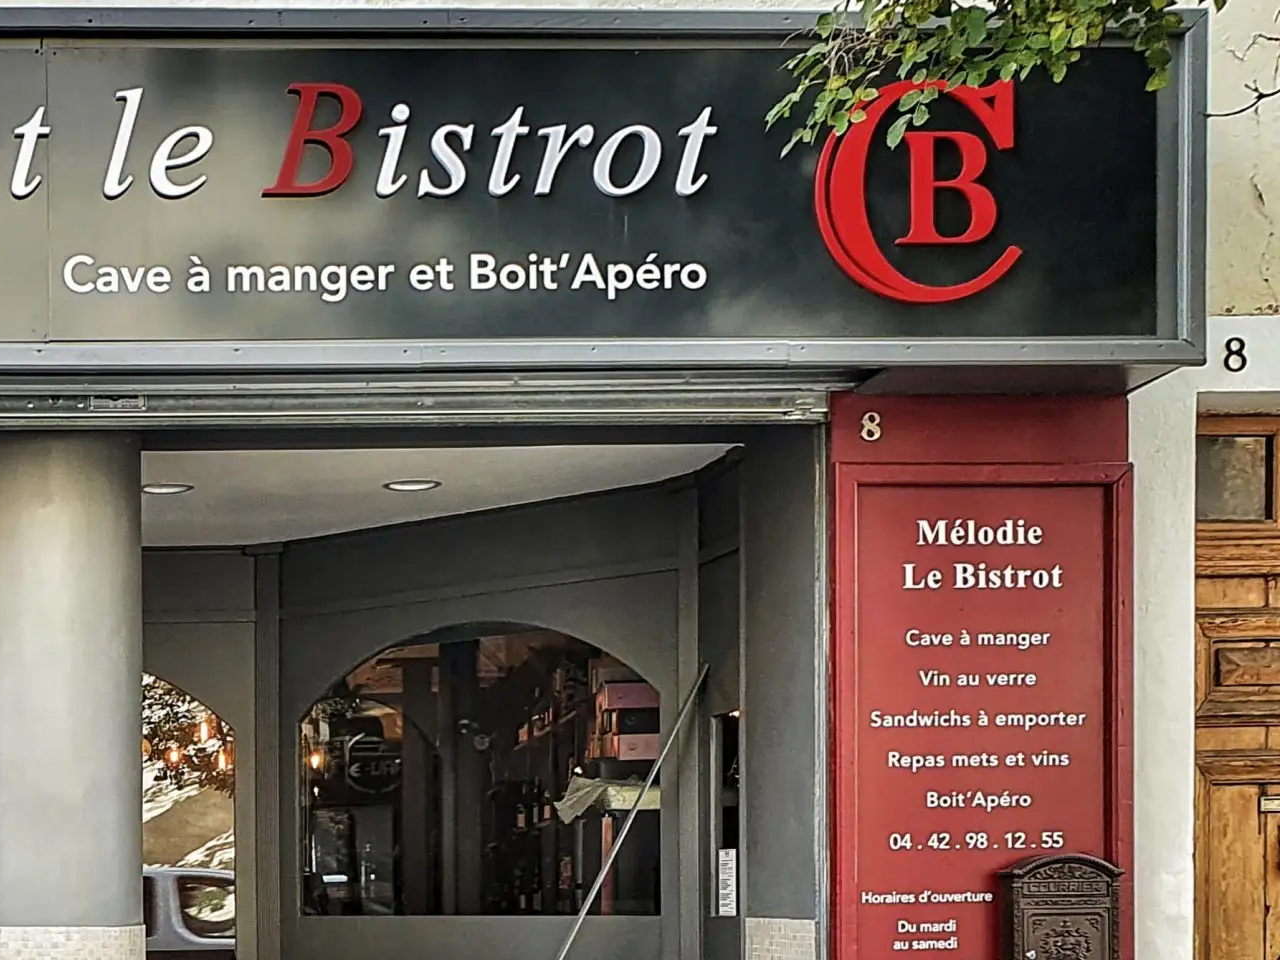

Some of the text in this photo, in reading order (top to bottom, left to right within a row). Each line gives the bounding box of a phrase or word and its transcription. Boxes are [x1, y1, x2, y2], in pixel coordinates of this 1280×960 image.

[102, 87, 215, 199] le
[261, 82, 718, 199] Bistrot
[61, 253, 708, 304] Cave à manger et Boit'Apéro
[1223, 336, 1248, 373] 8
[860, 411, 882, 442] 8
[915, 517, 1044, 547] Mélodie
[902, 562, 1064, 590] Le Bistrot
[905, 628, 1052, 651] Cave à manger
[918, 669, 1038, 687] Vin au verre
[869, 708, 1087, 732] Sandwichs à emporter
[887, 749, 1070, 773] Repas mets et vins
[926, 789, 1033, 813] Boit'Apéro
[861, 888, 994, 904] Horaires d'ouverture
[897, 918, 958, 934] Du mardi
[892, 935, 959, 951] au samedi
